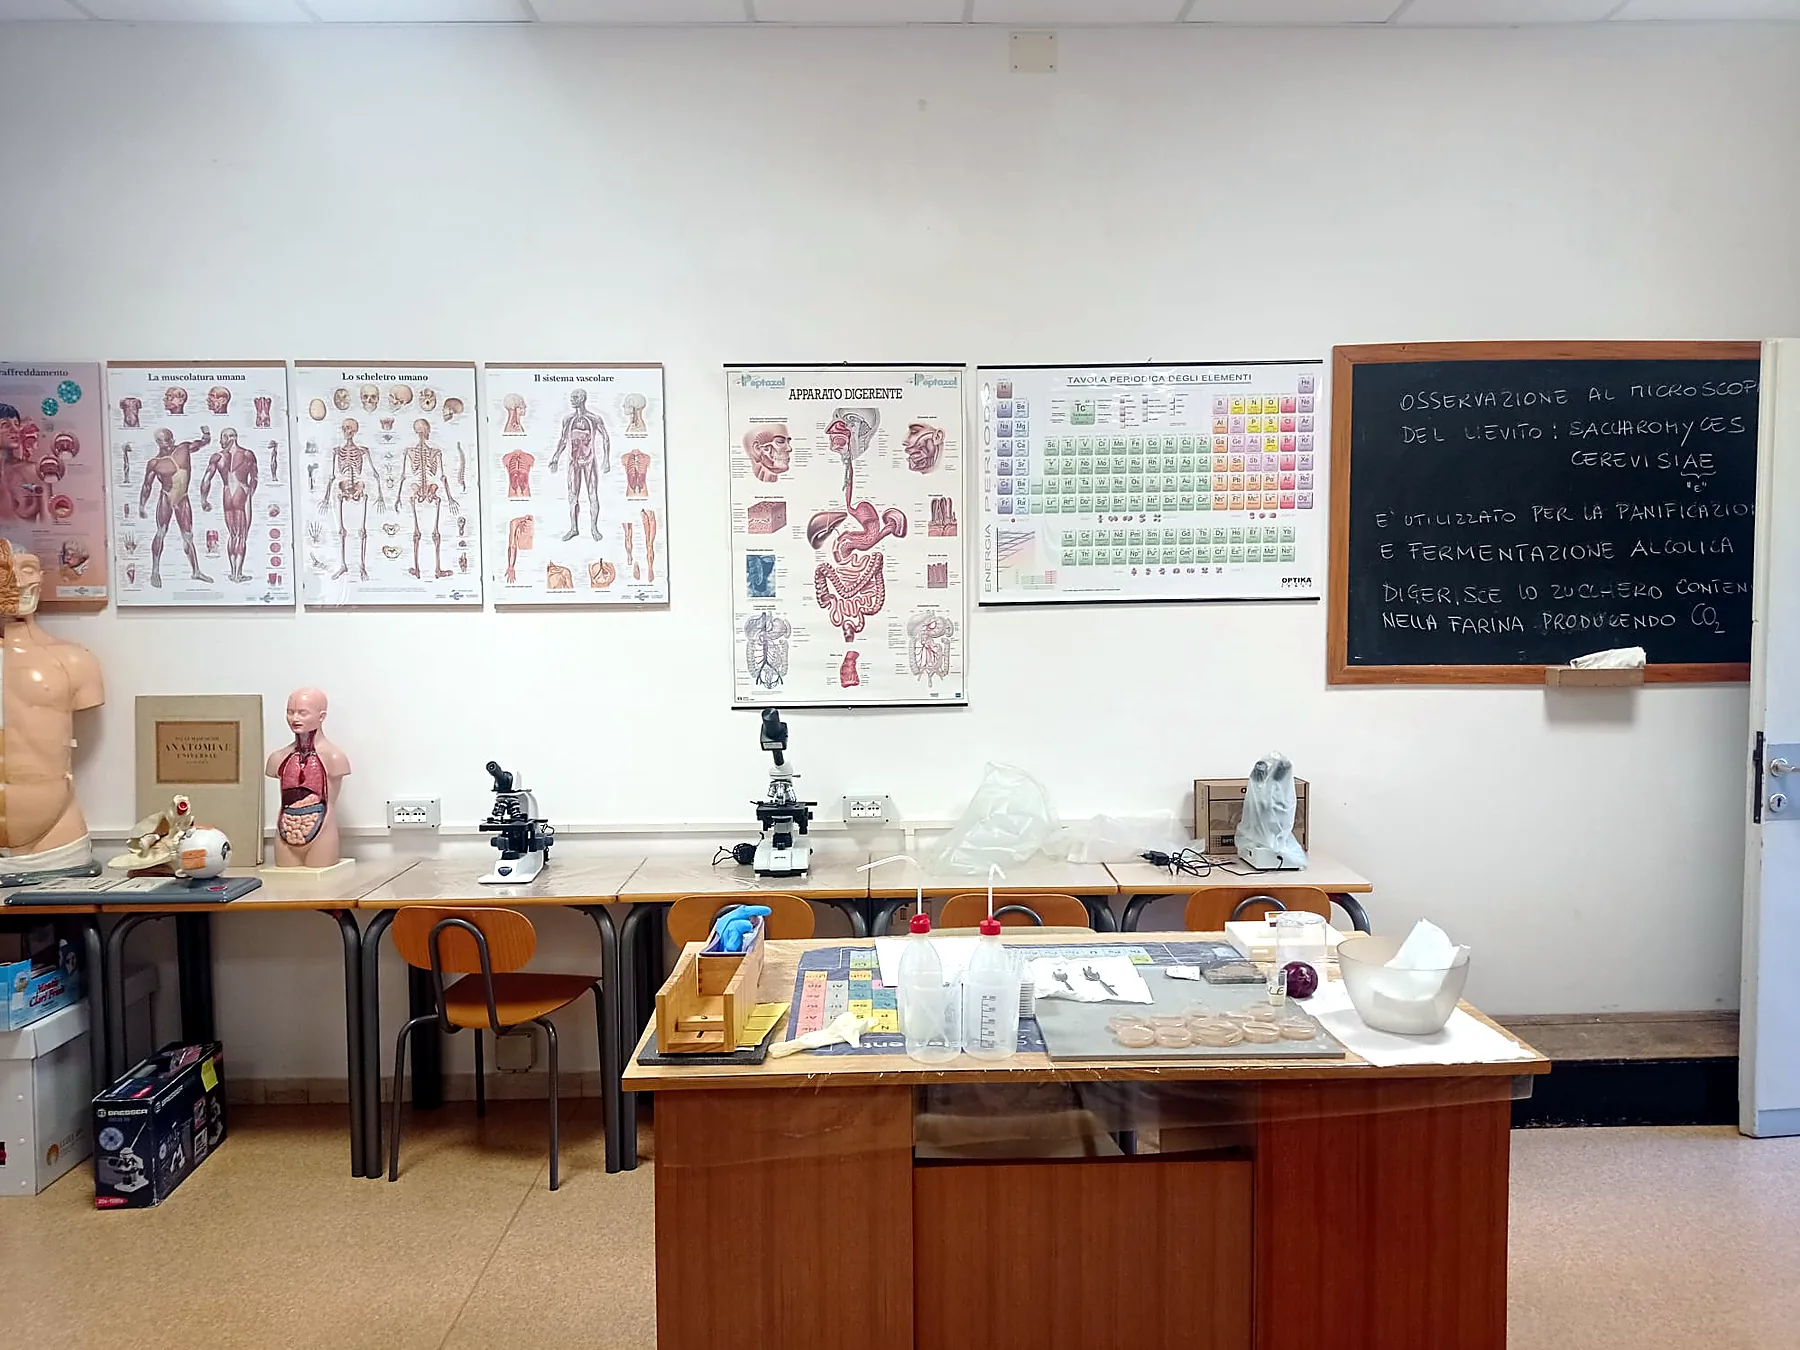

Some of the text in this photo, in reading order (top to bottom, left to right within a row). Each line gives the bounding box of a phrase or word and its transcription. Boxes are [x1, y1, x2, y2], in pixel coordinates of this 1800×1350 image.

[148, 373, 159, 381] La
[161, 373, 214, 381] muscolatura
[342, 372, 429, 382] Lo scheletro umano
[534, 374, 614, 383] Il sistema vascolare
[1110, 375, 1165, 383] PERIODICA
[1168, 374, 1198, 382] DEGLI
[1201, 373, 1252, 382] ELEMENTI
[788, 388, 903, 400] APPARATO DIGERENTE
[1399, 379, 1760, 412] OSSERVAZIONE AL MICROSCOP
[1401, 424, 1445, 444] DEL
[1403, 508, 1516, 528] UTILIZZATO
[1531, 505, 1573, 523] PER
[1583, 504, 1603, 521] LA
[1379, 536, 1735, 562] E FERMENTAZIONE ALCOLICA
[1517, 584, 1538, 601] LO
[1551, 583, 1663, 600] ZUCCHERO
[1675, 579, 1753, 595] CONTEN
[1381, 612, 1438, 631] NELLA
[1448, 615, 1524, 635] FARINA
[1542, 611, 1676, 632] PRODUCENDO
